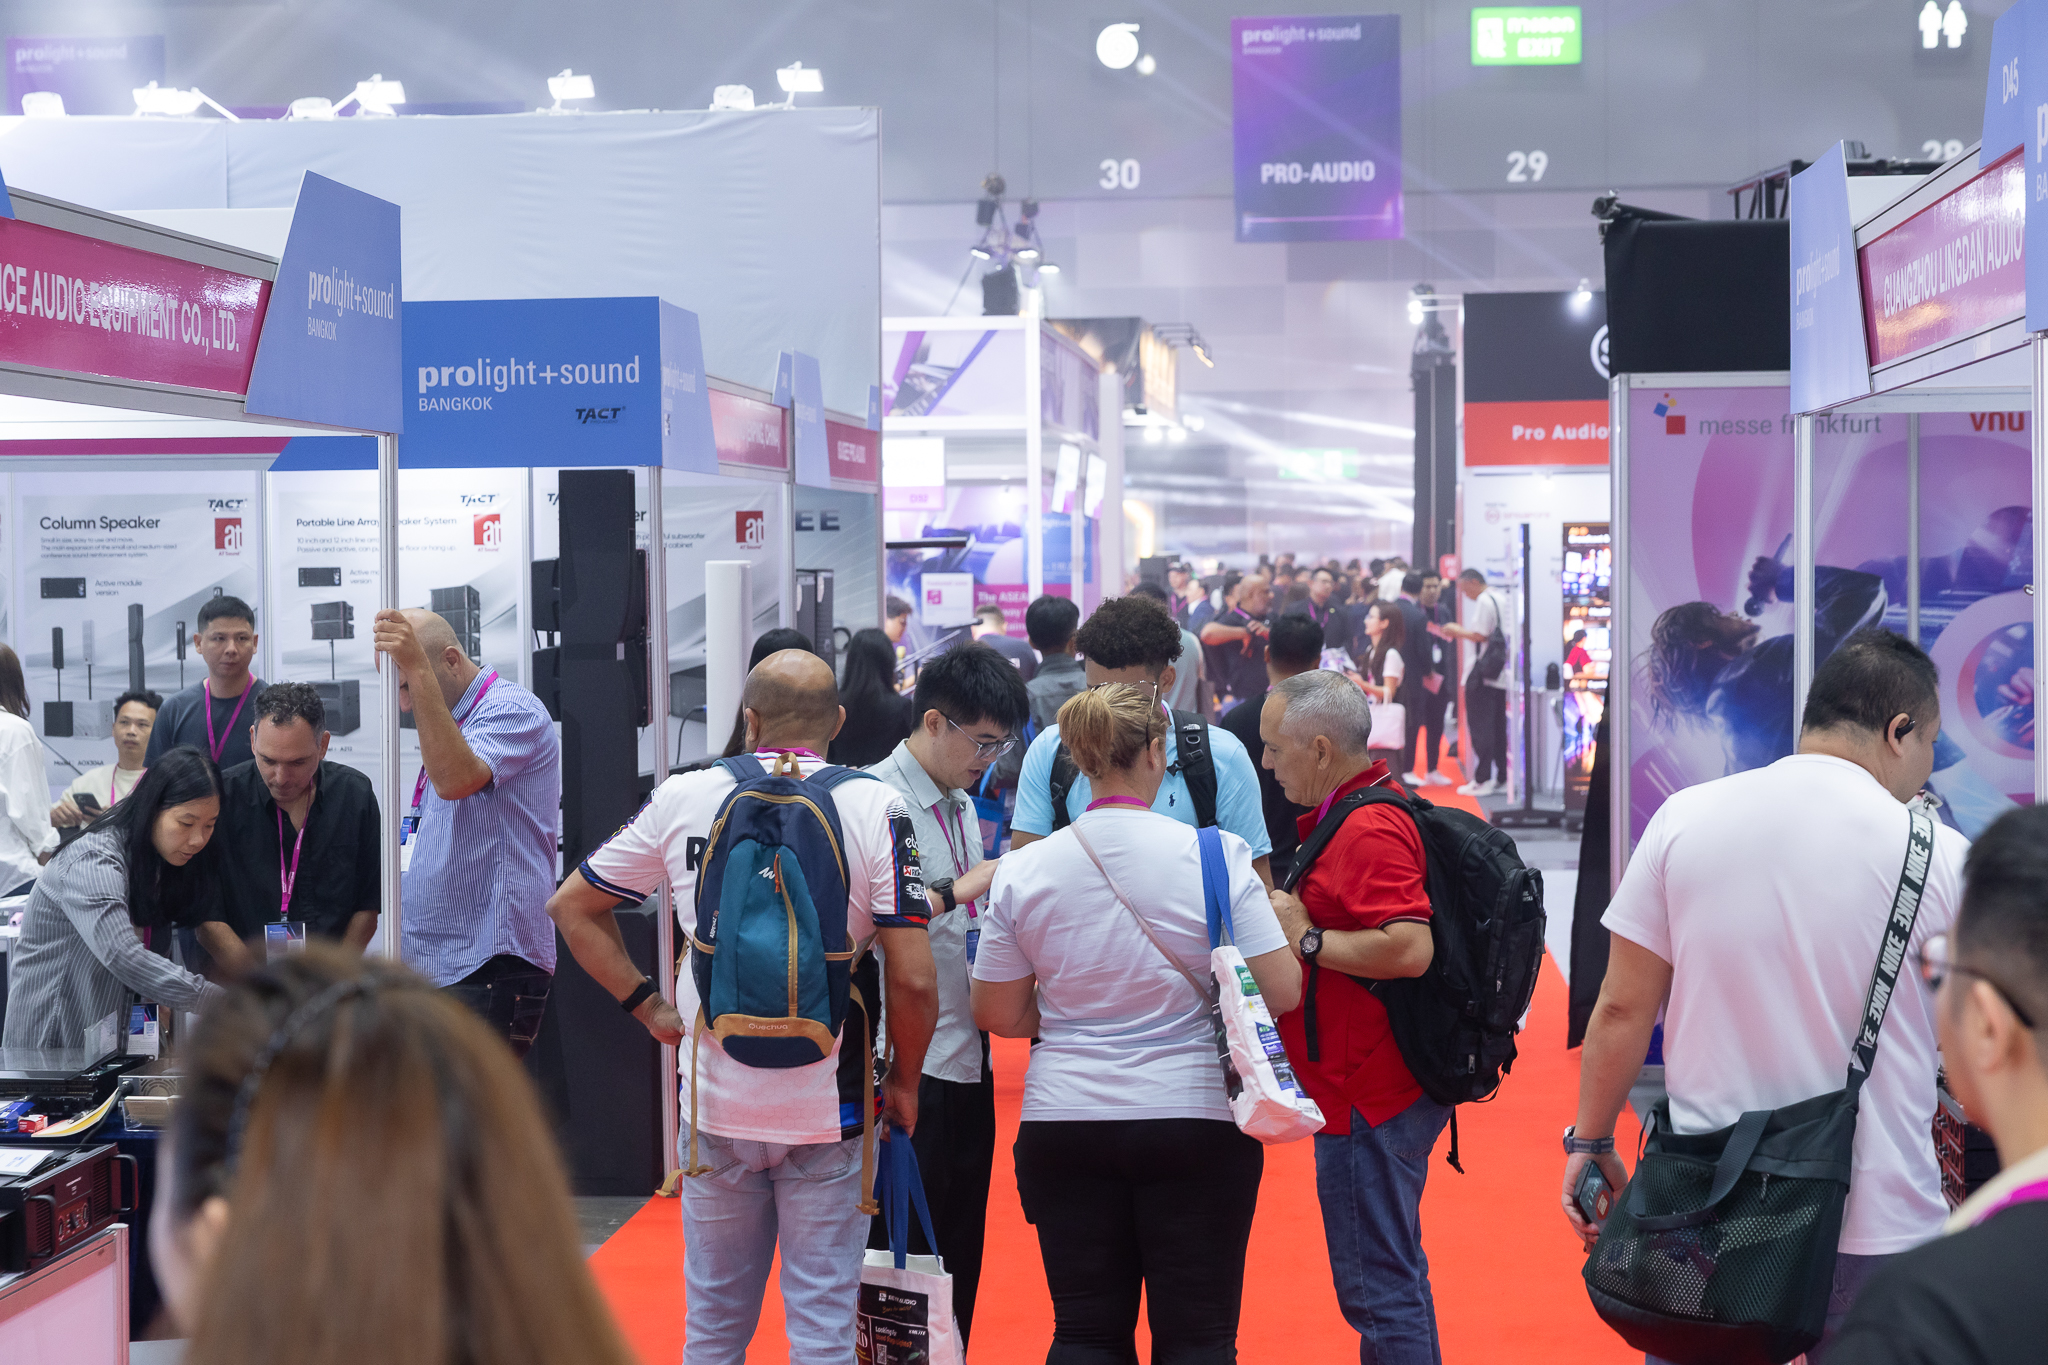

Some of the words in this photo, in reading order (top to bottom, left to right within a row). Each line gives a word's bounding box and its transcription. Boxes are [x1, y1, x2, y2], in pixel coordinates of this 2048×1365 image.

[1517, 37, 1564, 58] EXIT
[2003, 57, 2019, 104] D45
[1099, 158, 1141, 190] 30
[1261, 160, 1376, 184] PRO-AUDIO
[1506, 150, 1549, 182] 29
[1884, 251, 1937, 318] GUANGZHOU
[1939, 225, 1984, 293] LINGDAN
[1986, 208, 2022, 274] AUDIO
[308, 266, 393, 319] prolight+sound
[31, 270, 85, 325] AUDIO
[90, 281, 178, 341] EQUIPMENT
[212, 308, 240, 352] LTD.
[308, 316, 337, 341] BANGKOK
[418, 355, 640, 394] prolight+sound
[419, 397, 493, 411] BANGKOK
[1512, 424, 1545, 441] Pro
[1552, 423, 1609, 440] Audio
[1700, 419, 1772, 434] messe
[1781, 415, 1881, 434] frnkfurt
[40, 516, 96, 530] Column
[100, 515, 160, 532] Speaker
[296, 517, 335, 527] Portable
[337, 518, 355, 527] Line
[424, 517, 457, 527] System
[1905, 839, 1928, 886] NIKE
[1893, 883, 1919, 933] NIKE
[1880, 930, 1906, 979] NIKE
[1868, 977, 1890, 1026] NIKE
